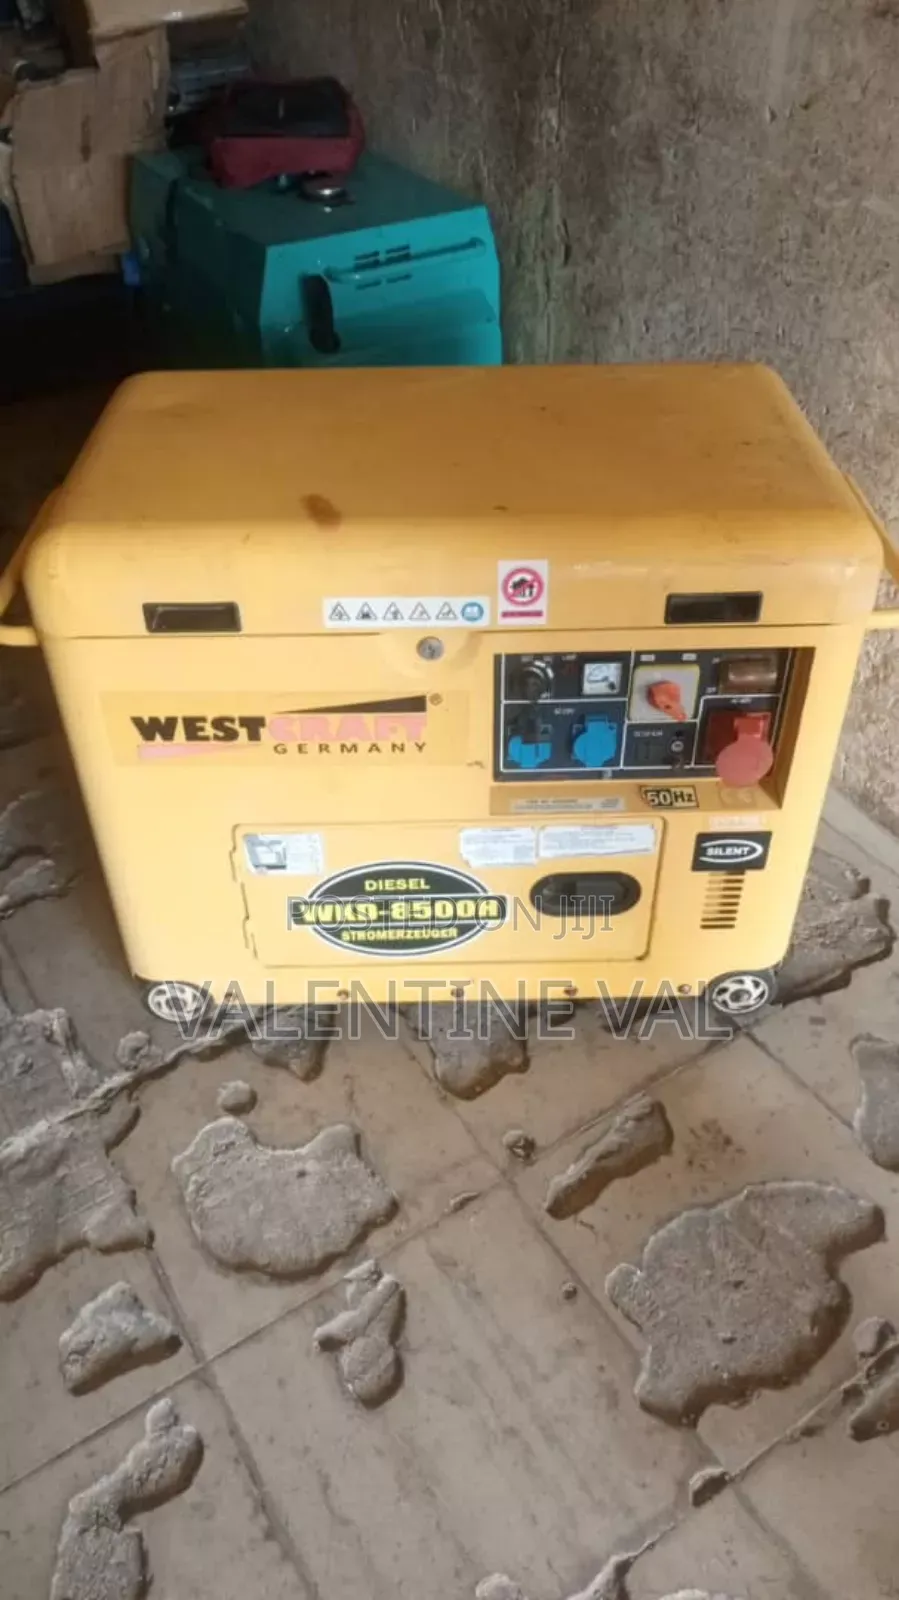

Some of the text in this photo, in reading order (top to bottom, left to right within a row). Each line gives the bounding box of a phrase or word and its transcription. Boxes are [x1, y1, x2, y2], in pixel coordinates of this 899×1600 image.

[130, 714, 427, 742] WESTCRAFT
[274, 742, 427, 755] GERMANY
[646, 787, 695, 807] 50Hz
[706, 846, 750, 856] SILENT
[364, 878, 431, 892] DIESEL
[341, 927, 458, 943] STROMERZEUGER
